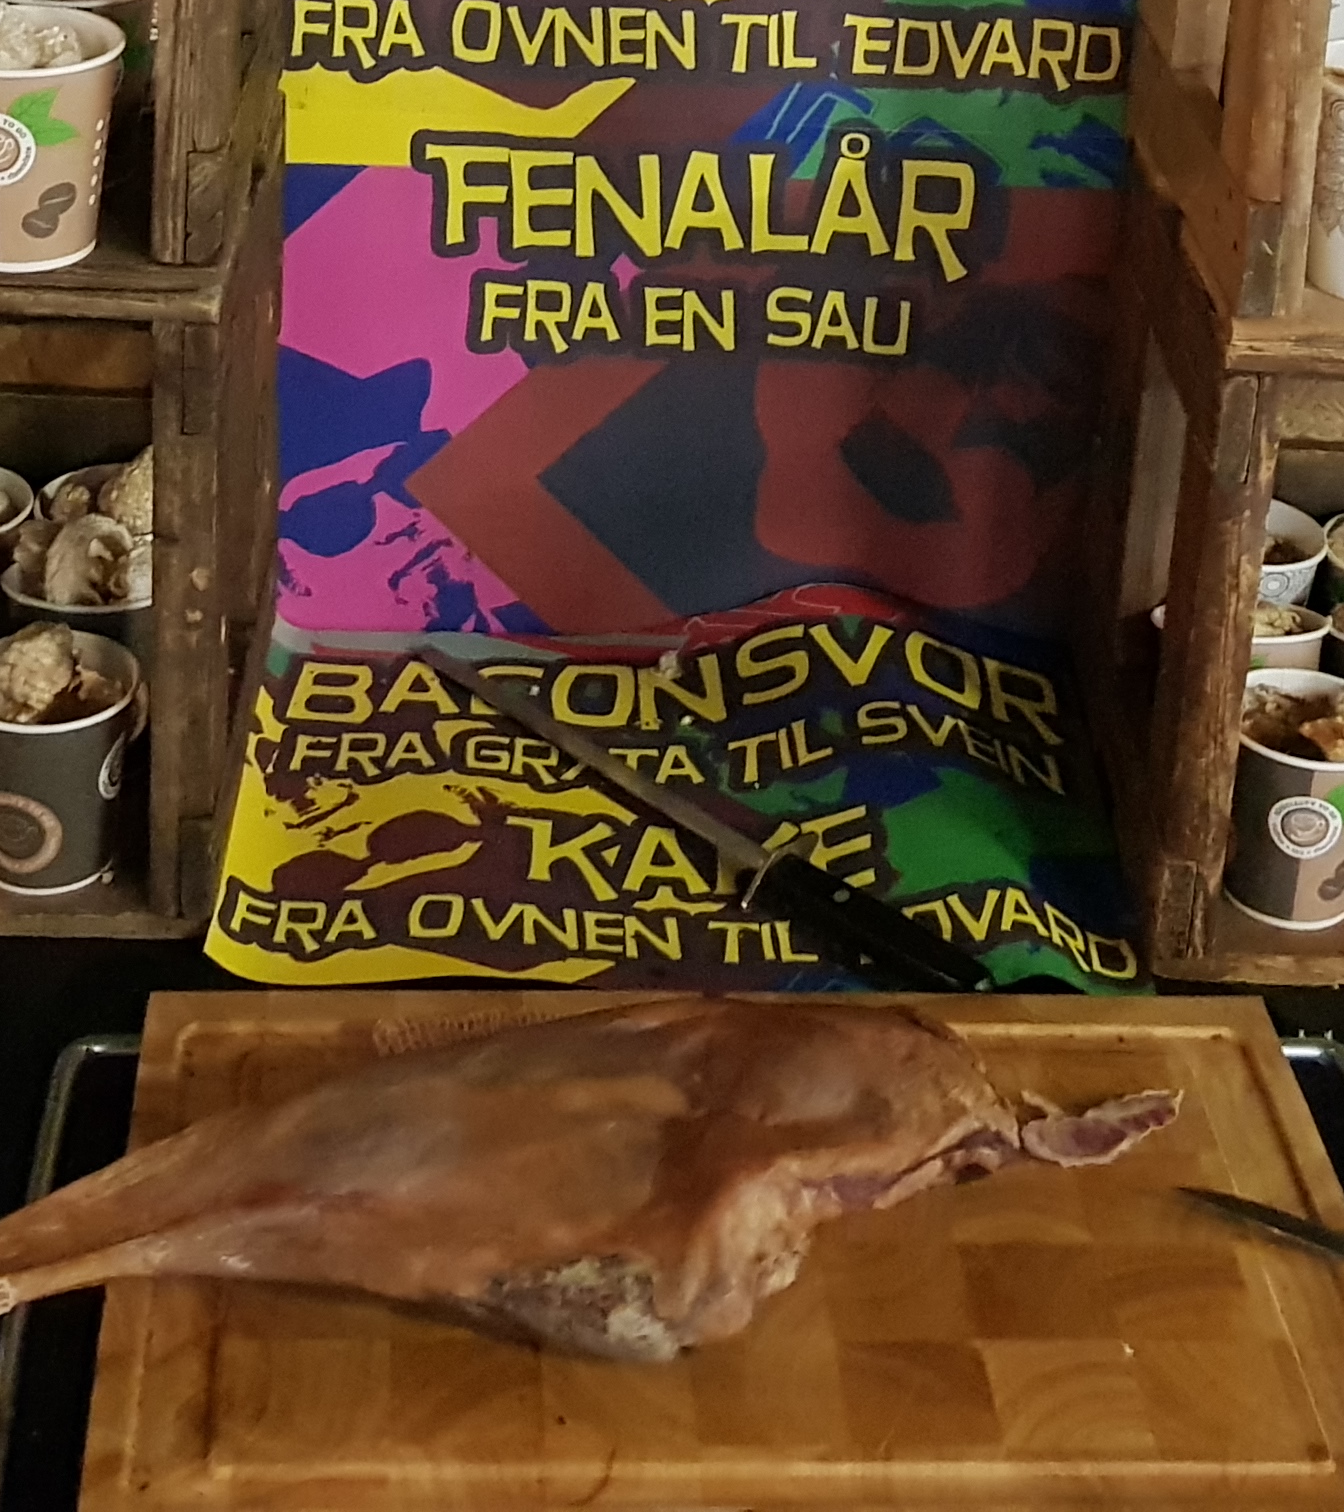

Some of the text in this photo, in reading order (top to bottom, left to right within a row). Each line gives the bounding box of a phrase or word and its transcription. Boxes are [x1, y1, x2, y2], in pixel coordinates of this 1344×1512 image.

[721, 13, 817, 73] TIL
[842, 14, 1122, 90] EDVARD
[425, 133, 975, 283] FENALÅR
[480, 280, 911, 356] FRA EN SAU
[290, 731, 436, 777] FRA
[729, 719, 833, 788] TIL
[861, 700, 1067, 796] SVEIN
[229, 886, 1138, 980] FRA OVNEN TIL DVARD
